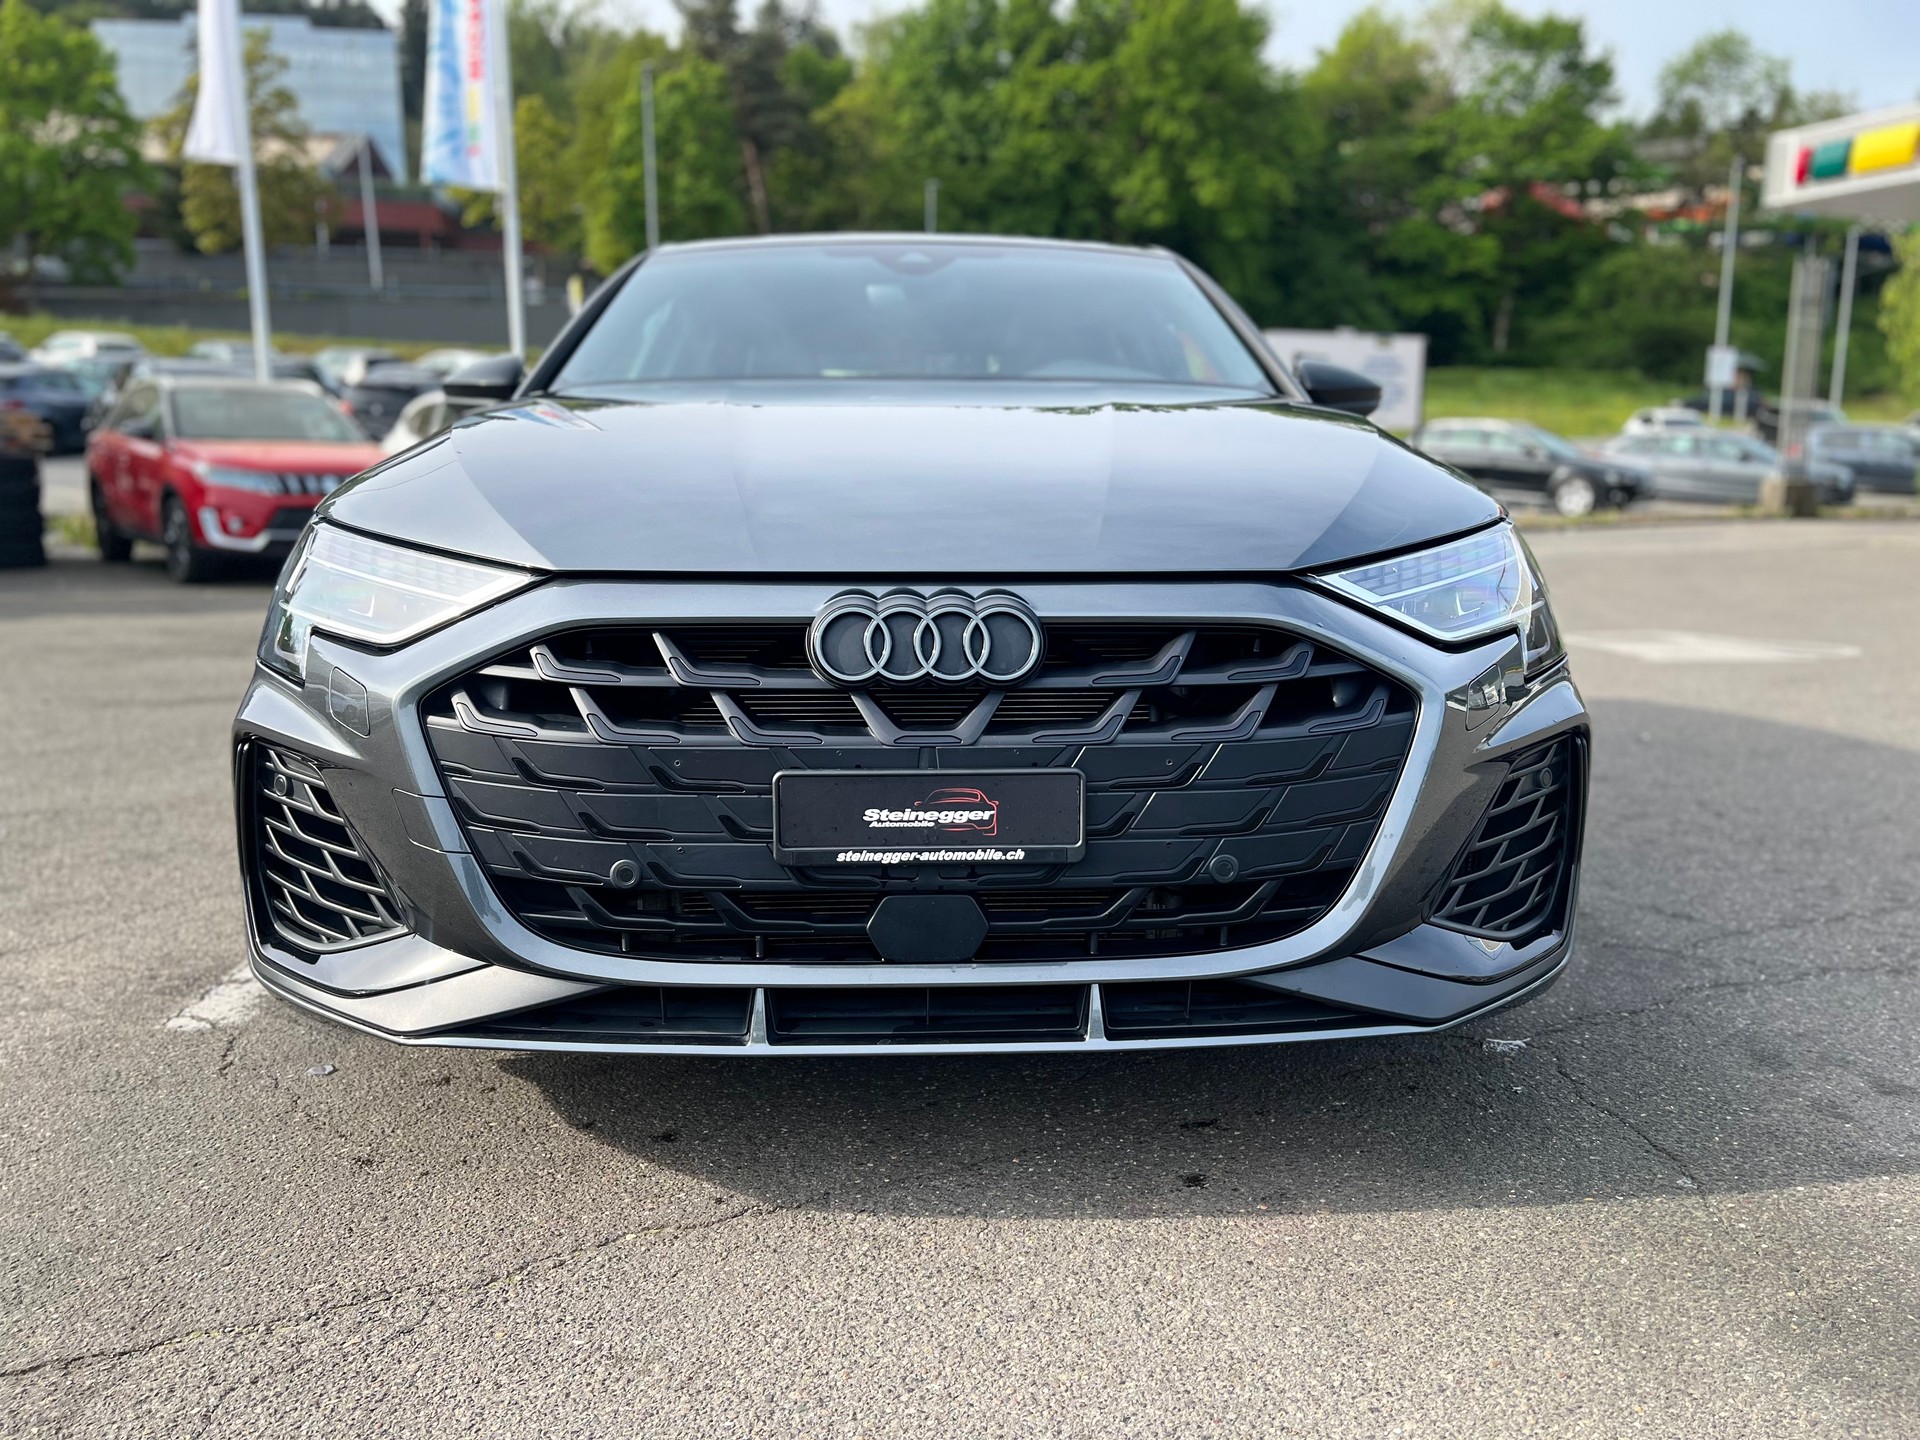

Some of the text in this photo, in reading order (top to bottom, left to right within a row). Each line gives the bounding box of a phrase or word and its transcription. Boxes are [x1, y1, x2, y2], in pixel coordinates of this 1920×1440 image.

[862, 808, 995, 823] Steinegger
[868, 820, 935, 828] Automobile
[836, 848, 1025, 864] steinegger-automobile.ch
